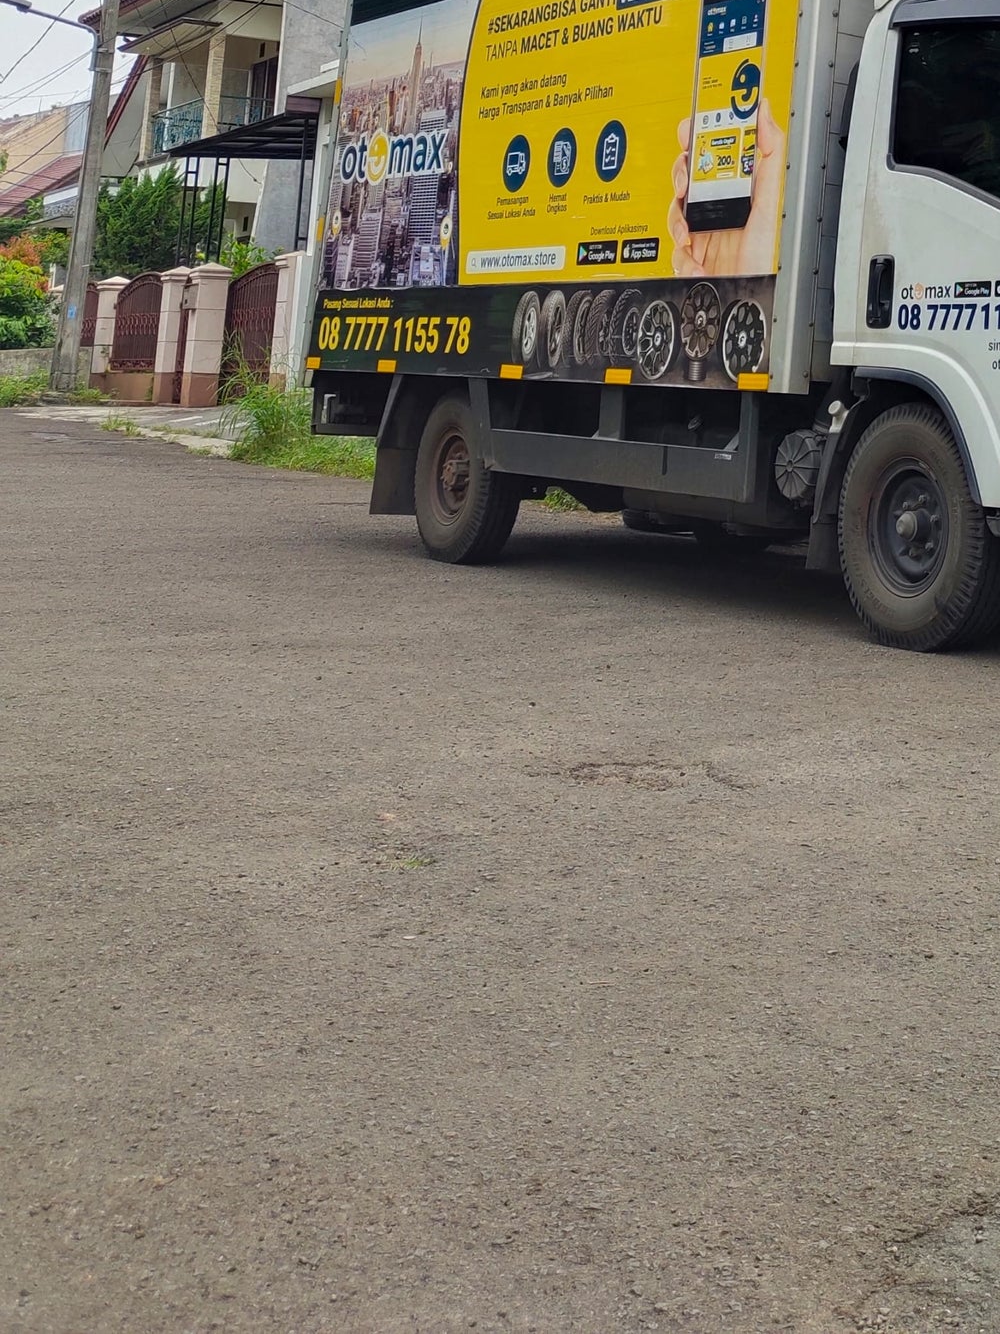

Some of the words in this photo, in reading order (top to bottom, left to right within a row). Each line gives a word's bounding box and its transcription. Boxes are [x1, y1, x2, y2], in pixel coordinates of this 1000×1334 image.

[488, 0, 577, 35] #SEKARANGBISA
[485, 41, 518, 62] TANPA
[520, 28, 560, 55] MACET
[561, 26, 569, 45] &
[572, 17, 614, 43] BUANG
[617, 5, 663, 33] WAKTU
[480, 84, 499, 99] Kami
[500, 83, 518, 99] yang
[520, 77, 538, 92] akan
[540, 73, 567, 88] datang
[478, 106, 500, 121] Harga
[502, 99, 543, 115] Transparan
[545, 95, 551, 108] &
[553, 89, 583, 108] Banyak
[584, 84, 614, 102] Pilihan
[496, 196, 529, 206] Pemasangan
[549, 193, 567, 203] Hemat
[583, 195, 604, 205] Praktis
[610, 191, 630, 202] Mudah
[487, 210, 504, 220] Sesuai
[505, 209, 521, 219] Lokasi
[522, 208, 536, 218] Anda
[546, 203, 567, 214] Ongkos
[590, 225, 616, 236] Download
[617, 223, 649, 236] Aplikasinya
[480, 251, 556, 269] www.otomax.store
[587, 250, 604, 262] Google
[604, 250, 616, 261] Play
[630, 249, 641, 260] App
[641, 248, 657, 258] Store
[964, 287, 980, 296] Google
[980, 287, 990, 296] Play
[323, 298, 341, 311] Pasang
[342, 298, 359, 309] Sesuai
[359, 297, 377, 308] Lokasi
[898, 303, 921, 331] 08
[318, 315, 340, 351] 08
[343, 315, 390, 352] 7777
[393, 316, 441, 354] 1155
[446, 315, 471, 355] 78
